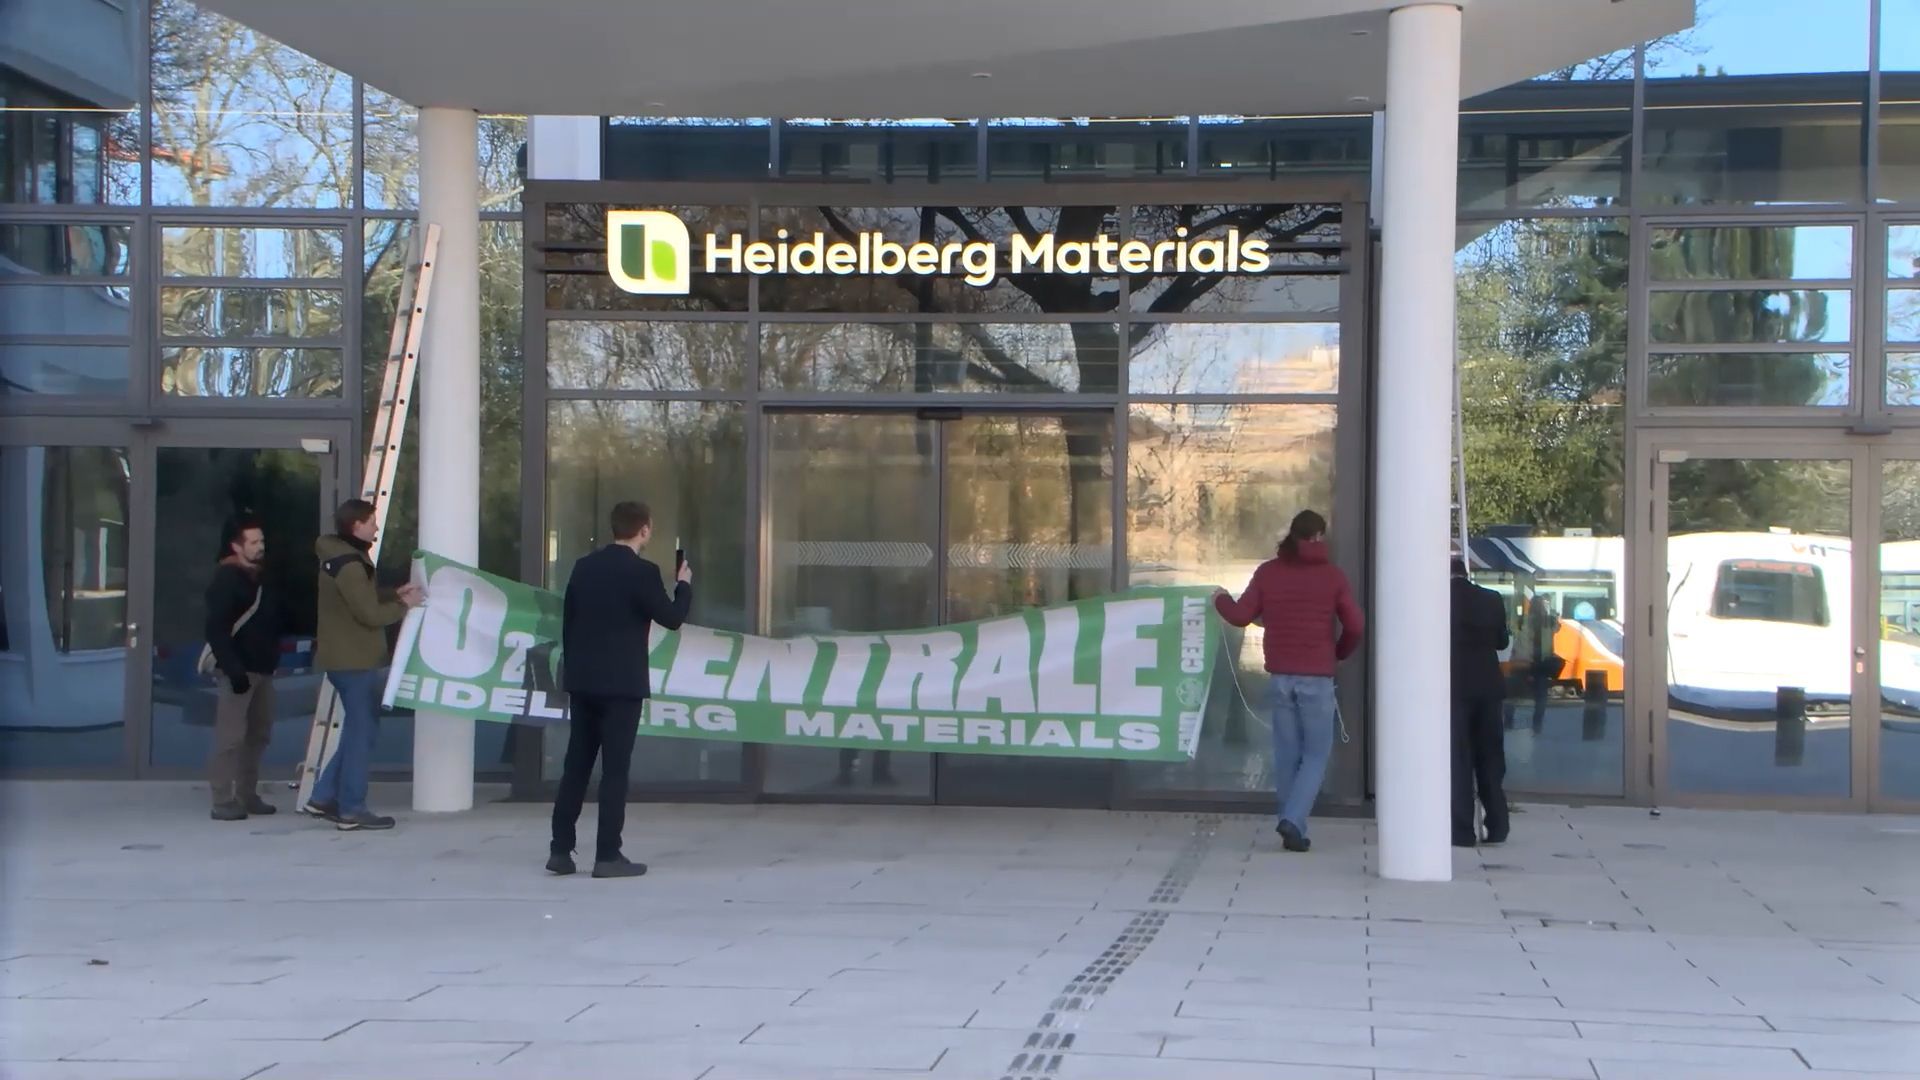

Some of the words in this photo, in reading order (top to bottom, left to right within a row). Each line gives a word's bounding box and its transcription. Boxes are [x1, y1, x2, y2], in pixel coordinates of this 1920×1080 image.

[706, 229, 996, 287] Heidelberg
[1011, 227, 1271, 275] Materials
[1180, 596, 1206, 674] CEMENT
[785, 709, 1161, 751] MATERIALS
